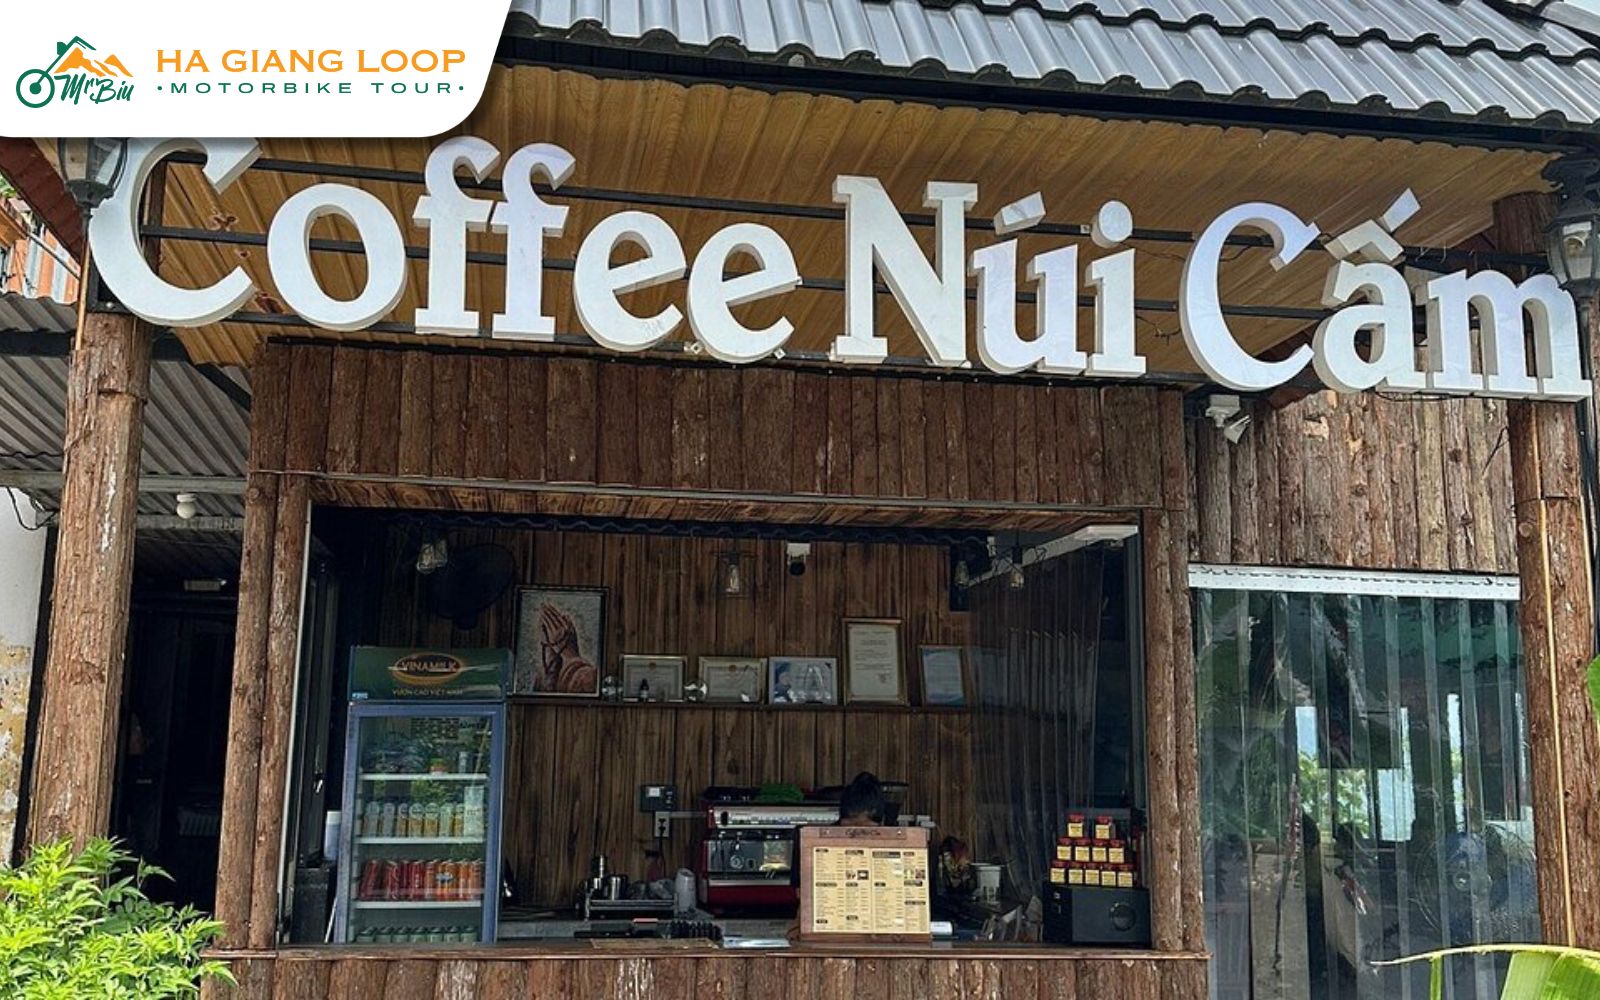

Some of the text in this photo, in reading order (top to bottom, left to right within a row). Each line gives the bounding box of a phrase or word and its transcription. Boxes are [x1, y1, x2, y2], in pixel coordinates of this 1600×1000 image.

[88, 136, 1593, 401] Coffee Núi Cấm
